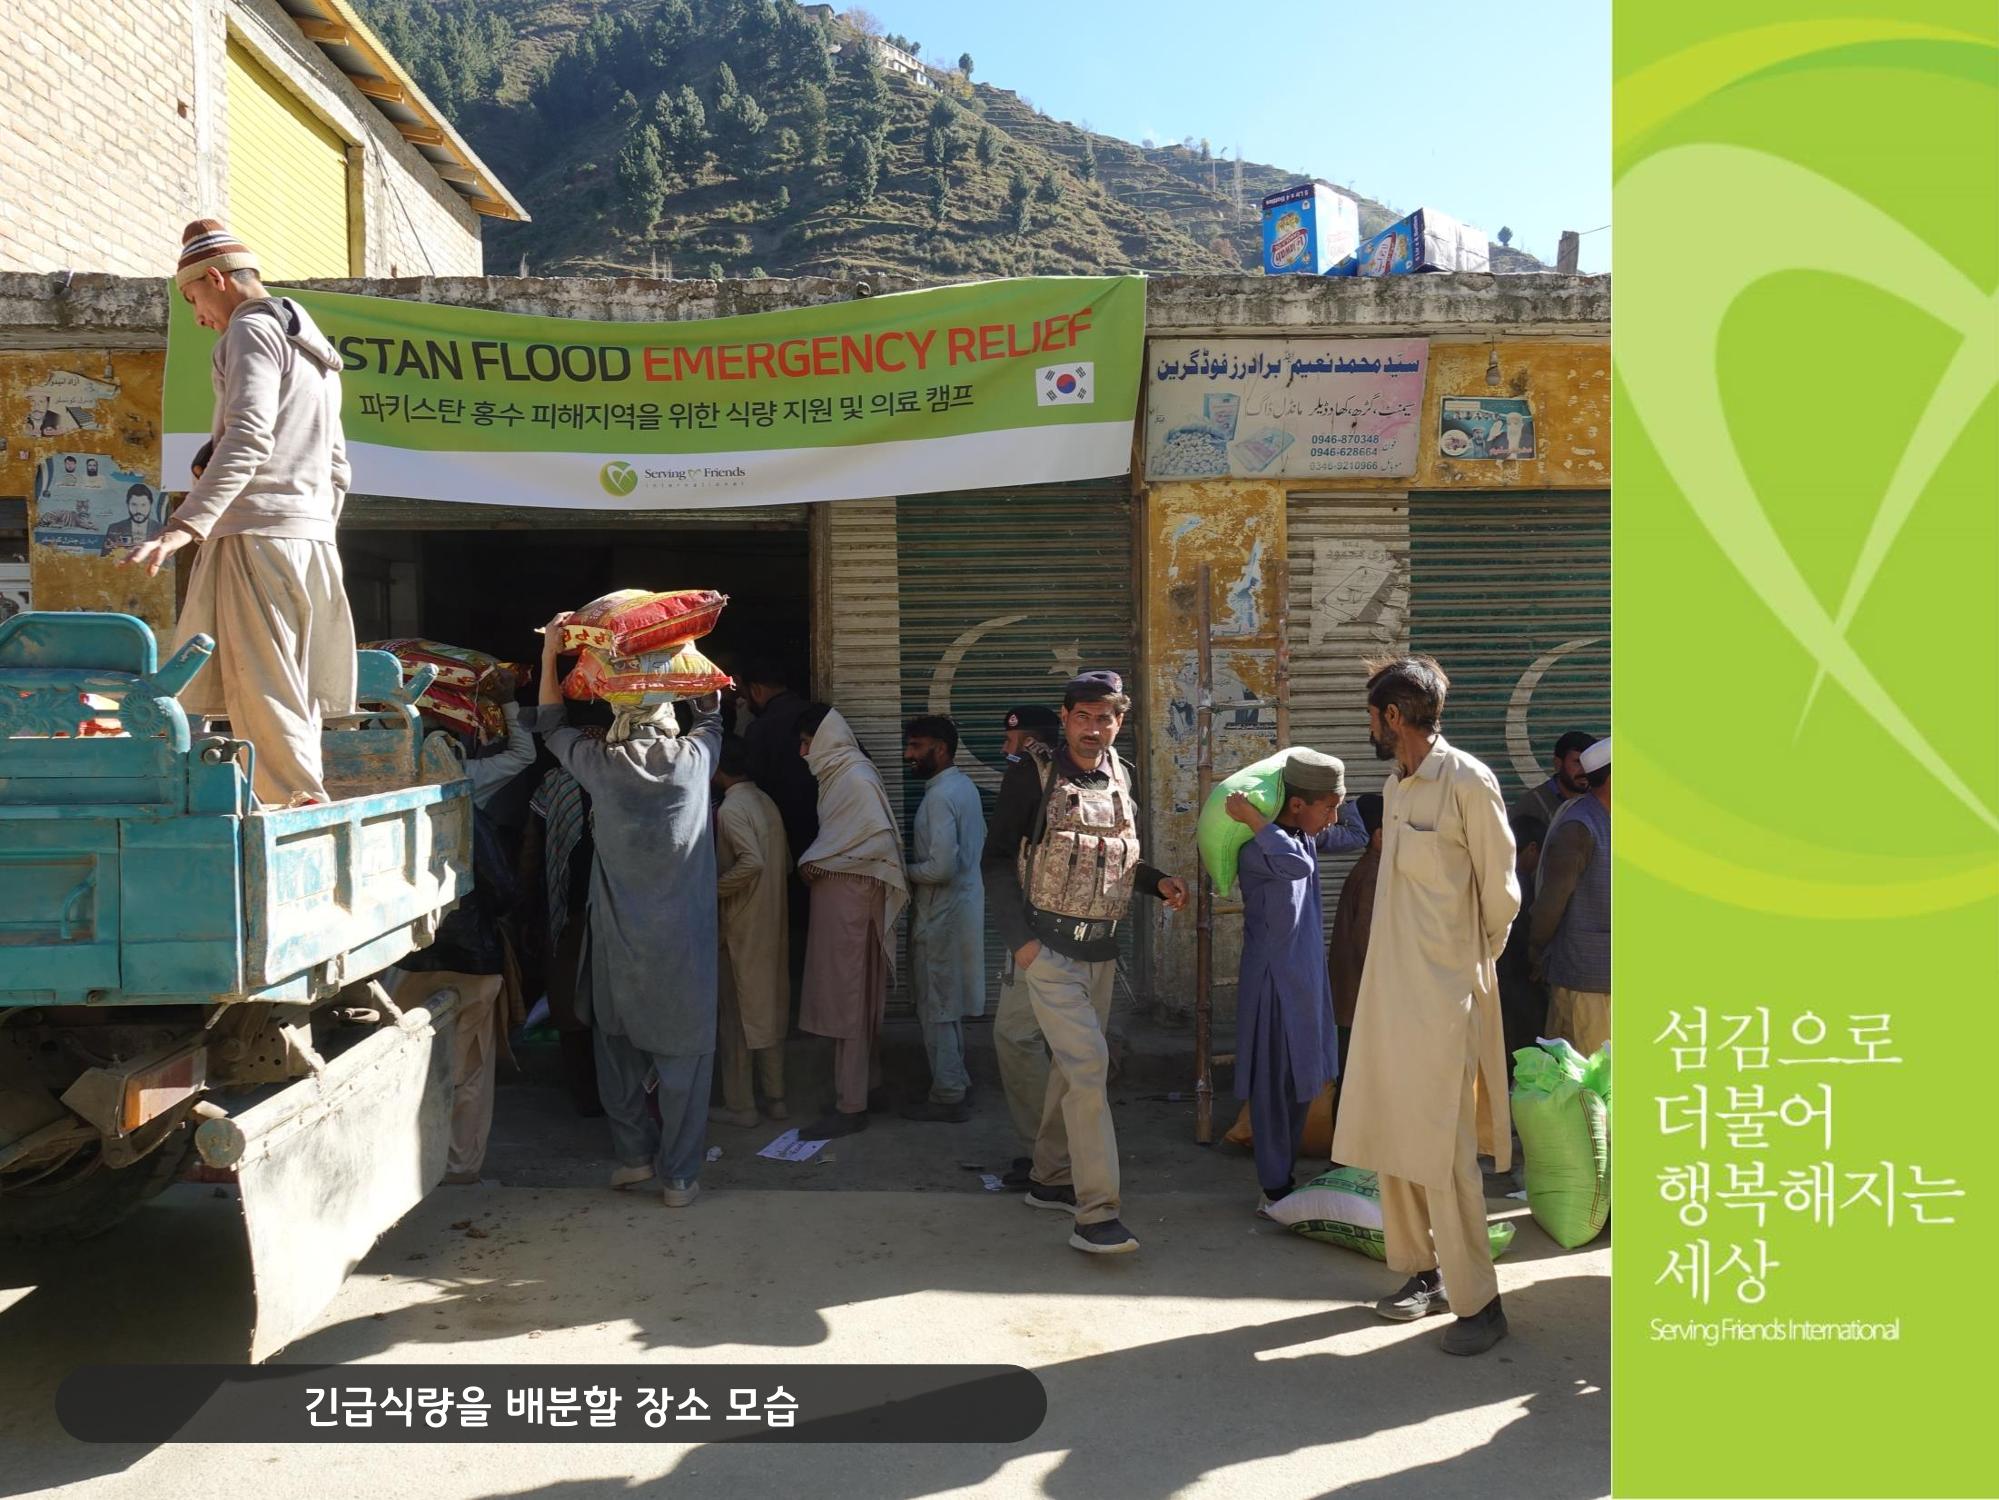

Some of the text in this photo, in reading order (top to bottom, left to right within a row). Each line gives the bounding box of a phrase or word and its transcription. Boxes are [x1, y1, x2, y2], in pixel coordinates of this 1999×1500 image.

[471, 341, 631, 382] FLOOD
[643, 329, 937, 382] EMERGENCY
[948, 307, 1093, 367] RELIEF
[1286, 353, 1333, 388] نعیم
[1335, 356, 1381, 374] محمد
[359, 383, 974, 430] 파키스탄 홍수 피해지역을 위한 식량 지원 및 의료 캠프
[644, 466, 746, 480] Serving Friends
